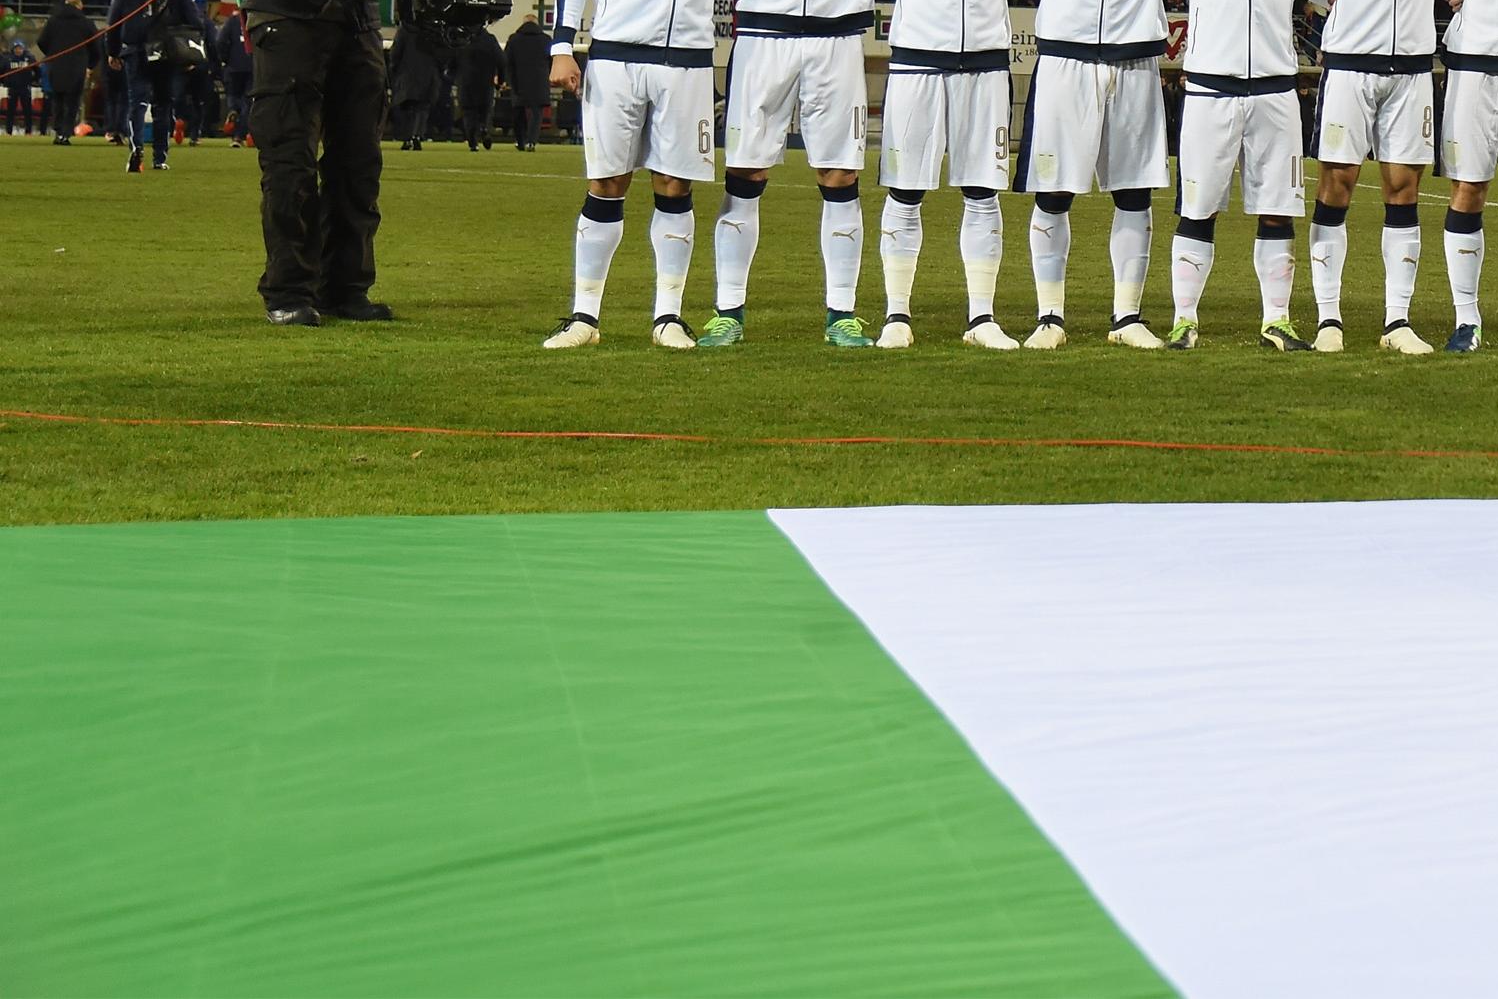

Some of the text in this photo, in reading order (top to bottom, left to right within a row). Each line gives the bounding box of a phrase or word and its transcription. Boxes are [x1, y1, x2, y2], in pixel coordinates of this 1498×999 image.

[697, 119, 711, 154] 6
[1422, 105, 1432, 138] 8
[995, 126, 1008, 161] 9
